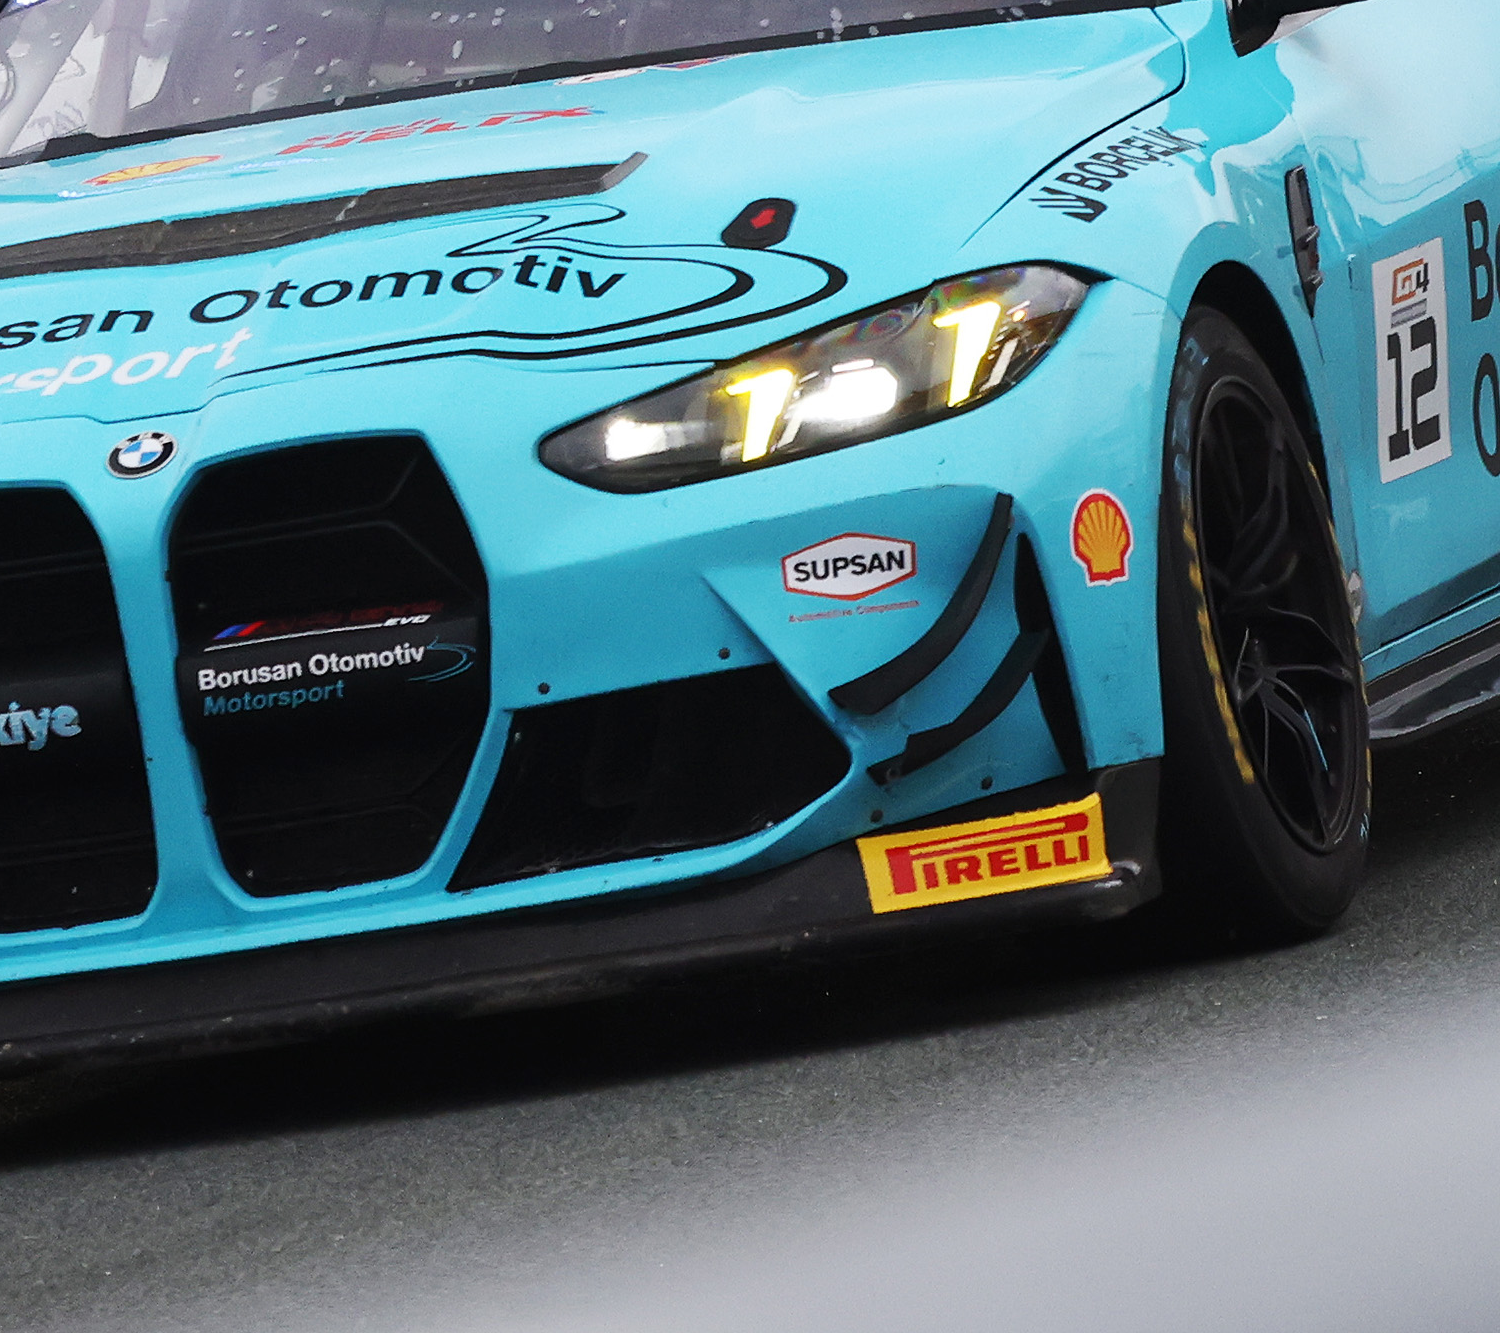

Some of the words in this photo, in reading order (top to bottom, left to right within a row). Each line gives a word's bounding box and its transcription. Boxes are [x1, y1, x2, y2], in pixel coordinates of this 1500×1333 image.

[188, 253, 628, 325] Otomotiv
[1387, 316, 1442, 462] 12
[793, 549, 905, 583] SUPSAN
[381, 613, 431, 627] EVO
[197, 660, 303, 691] Borusan
[307, 642, 425, 677] Otomotiv
[202, 678, 345, 717] Motorsport
[885, 812, 1090, 895] PIRELLI
